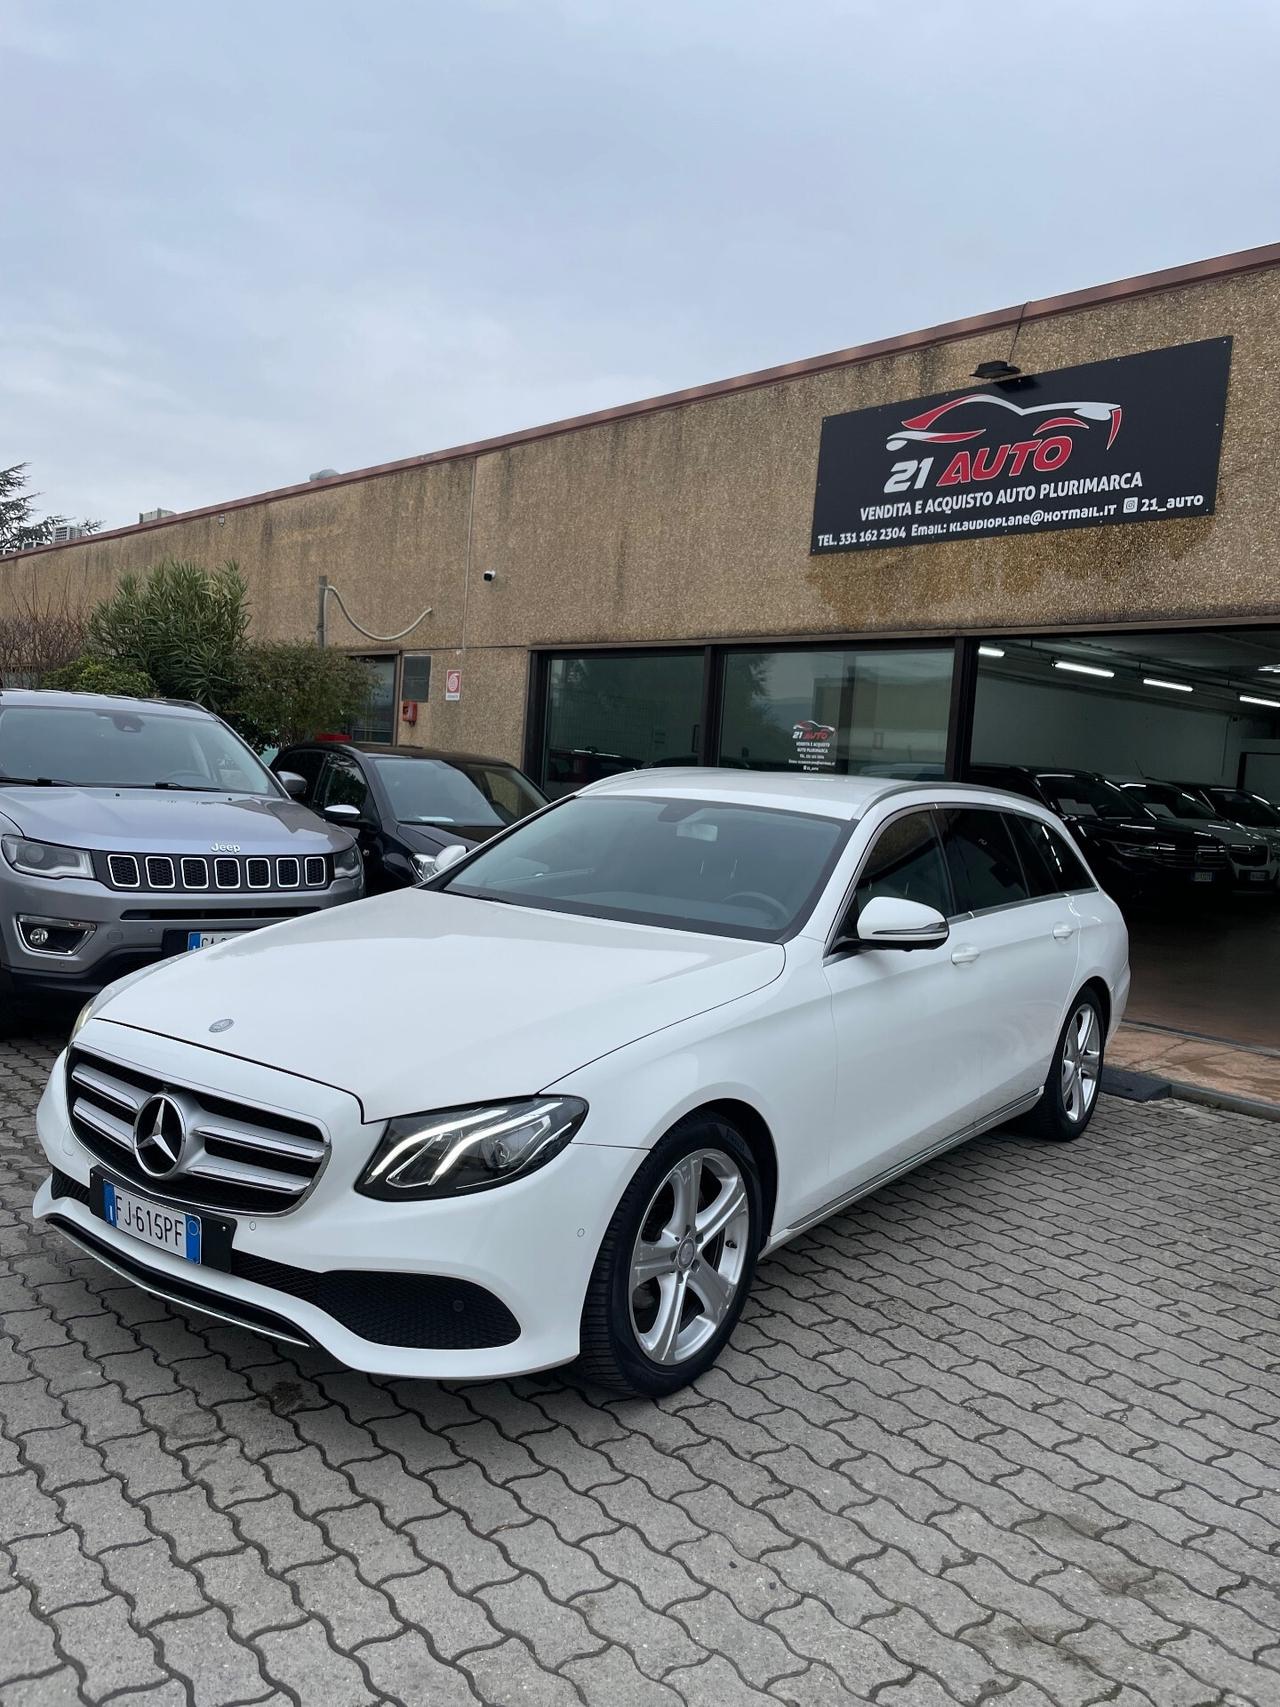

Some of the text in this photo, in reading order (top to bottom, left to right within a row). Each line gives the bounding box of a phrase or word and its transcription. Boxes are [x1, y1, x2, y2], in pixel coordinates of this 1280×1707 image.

[884, 435, 1073, 494] 21 AUTO
[860, 472, 1143, 521] VENDITA E ACQUISTO AUTO PLURIMARCA
[817, 534, 837, 547] TEL.
[839, 533, 857, 545] 331
[859, 531, 878, 542] 162
[879, 527, 906, 540] 2304
[792, 731, 828, 740] 21 AUTO
[210, 841, 241, 854] Jeep
[115, 1195, 184, 1247] FJ615PF
